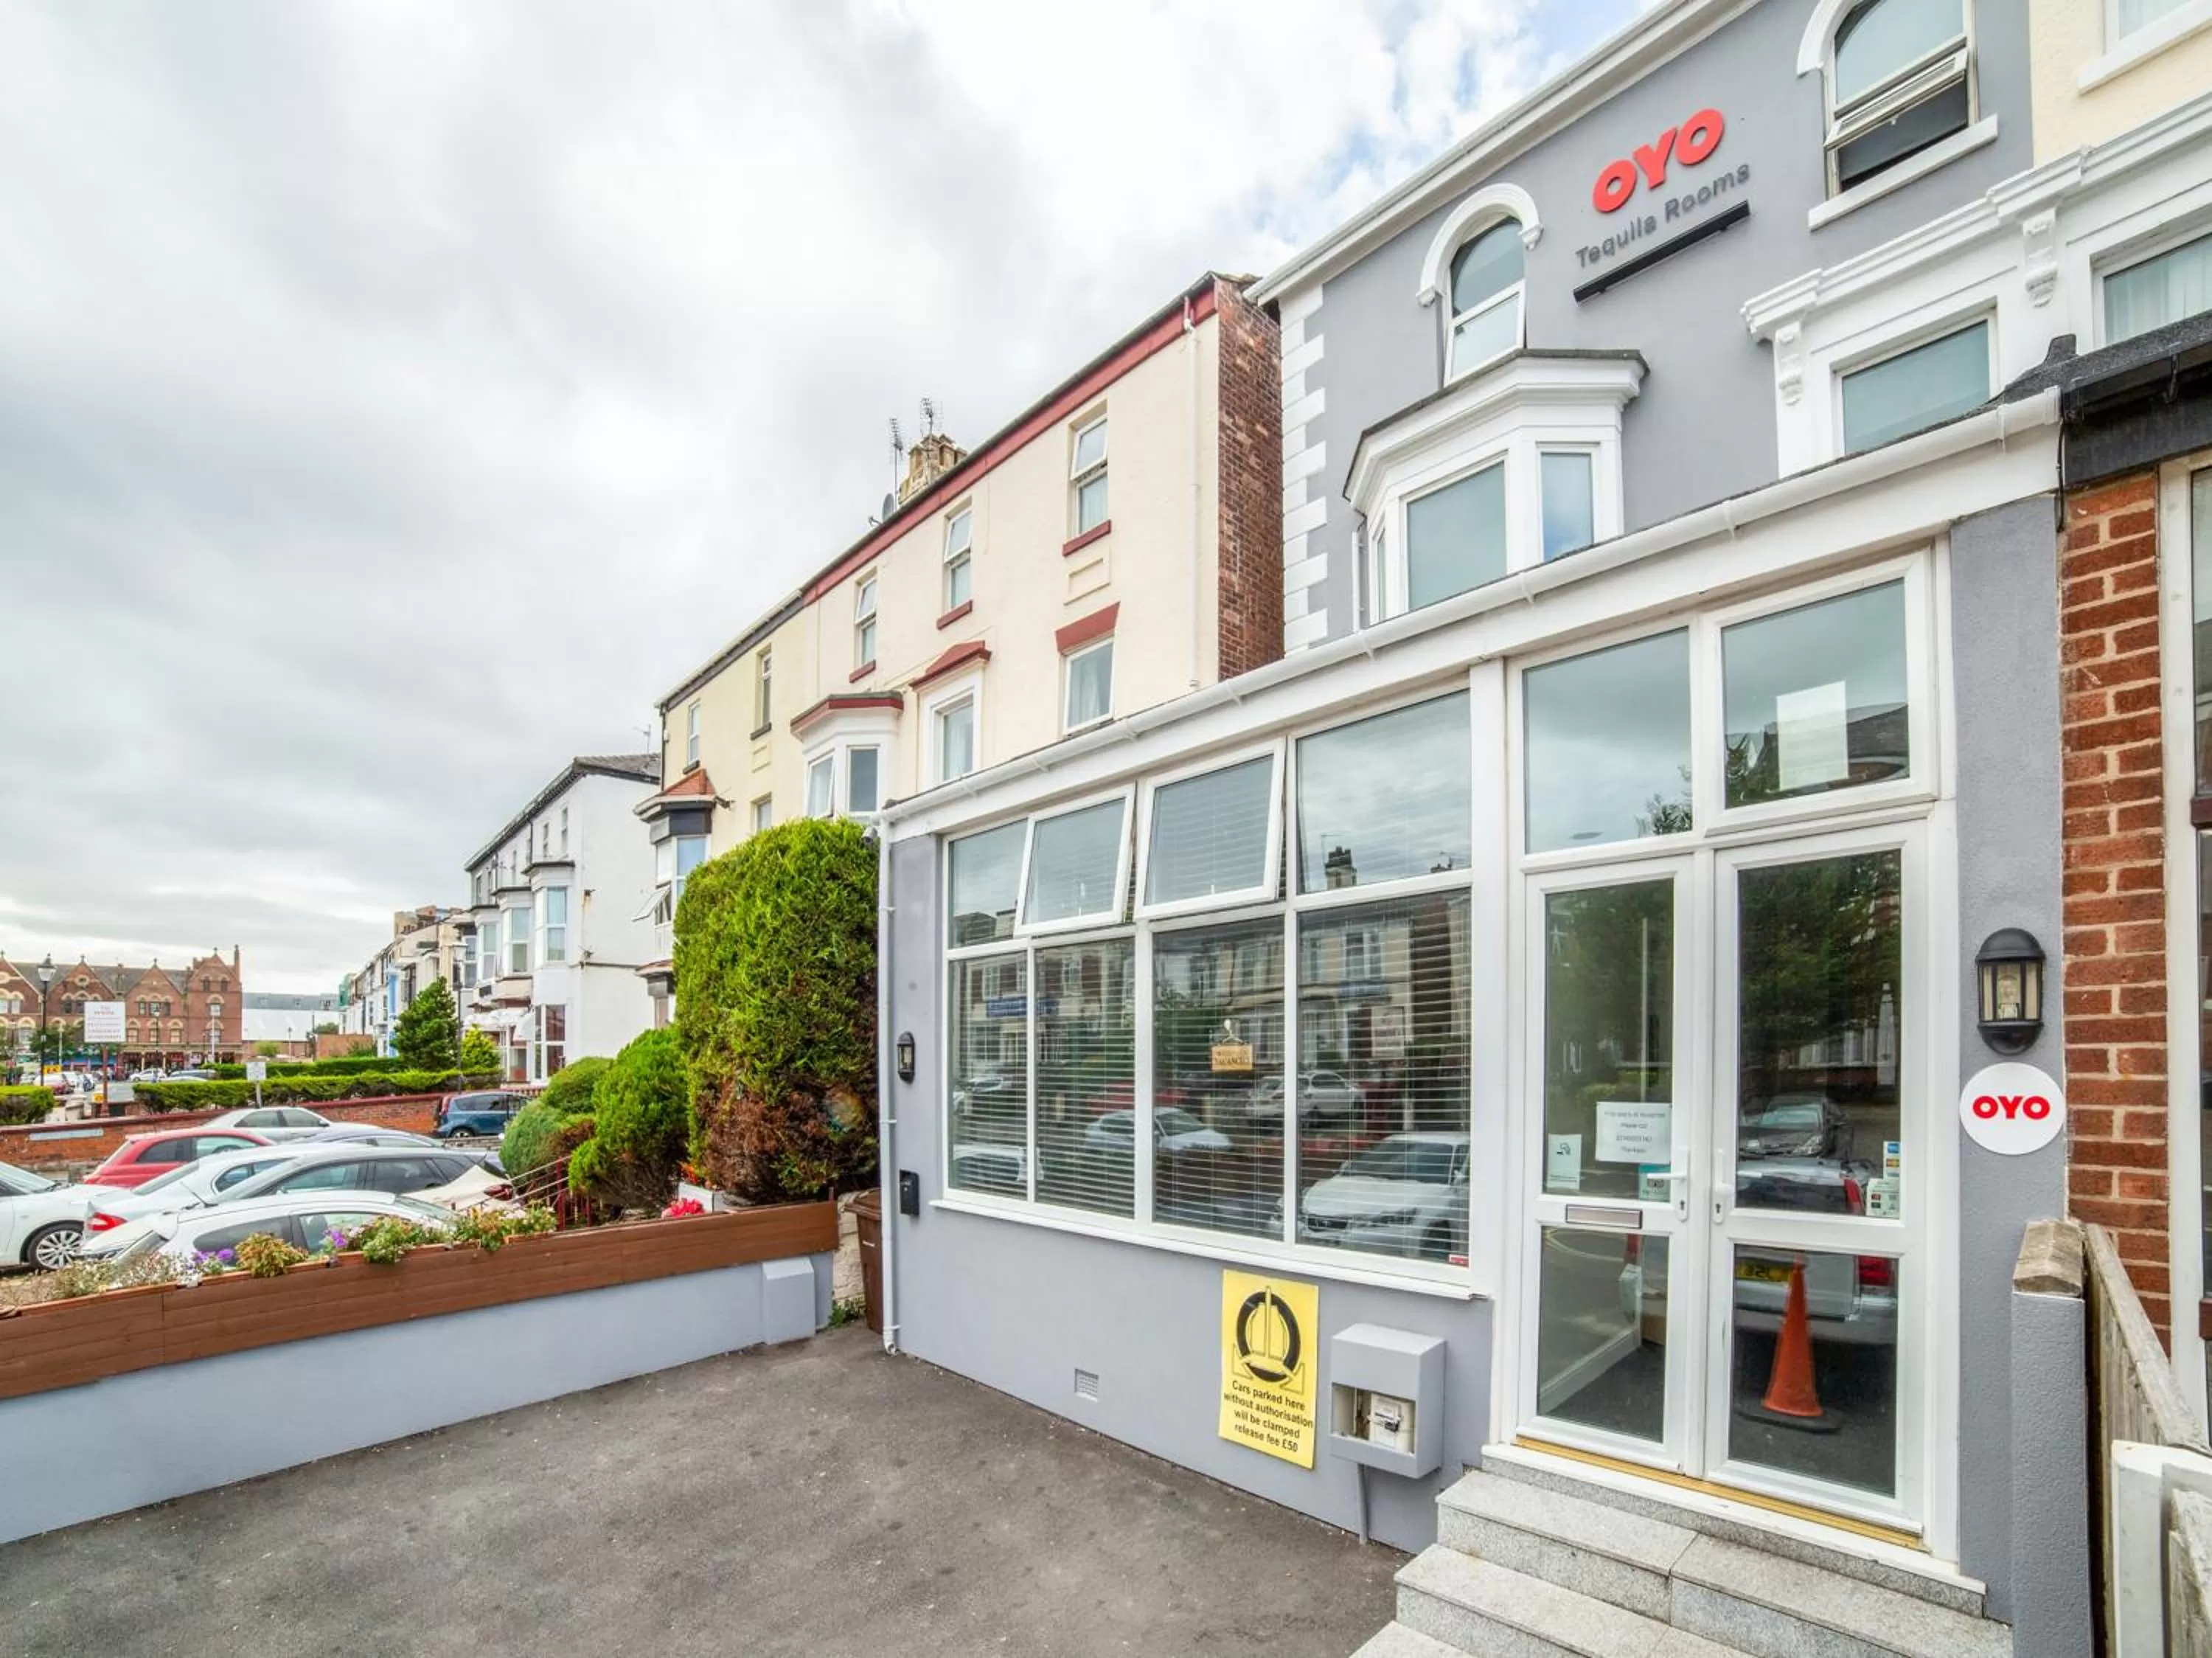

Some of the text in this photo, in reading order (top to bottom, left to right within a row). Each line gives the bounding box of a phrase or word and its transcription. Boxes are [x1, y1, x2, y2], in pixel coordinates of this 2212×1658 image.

[1593, 108, 1725, 213] OYO
[1575, 164, 1750, 268] Tequila Rooms
[1972, 1095, 2051, 1120] OYO
[1224, 1392, 1313, 1428] without authorisation
[1232, 1380, 1306, 1411] Cars parked here
[1234, 1410, 1300, 1439] will be clamped
[1234, 1424, 1298, 1452] release fee £50
